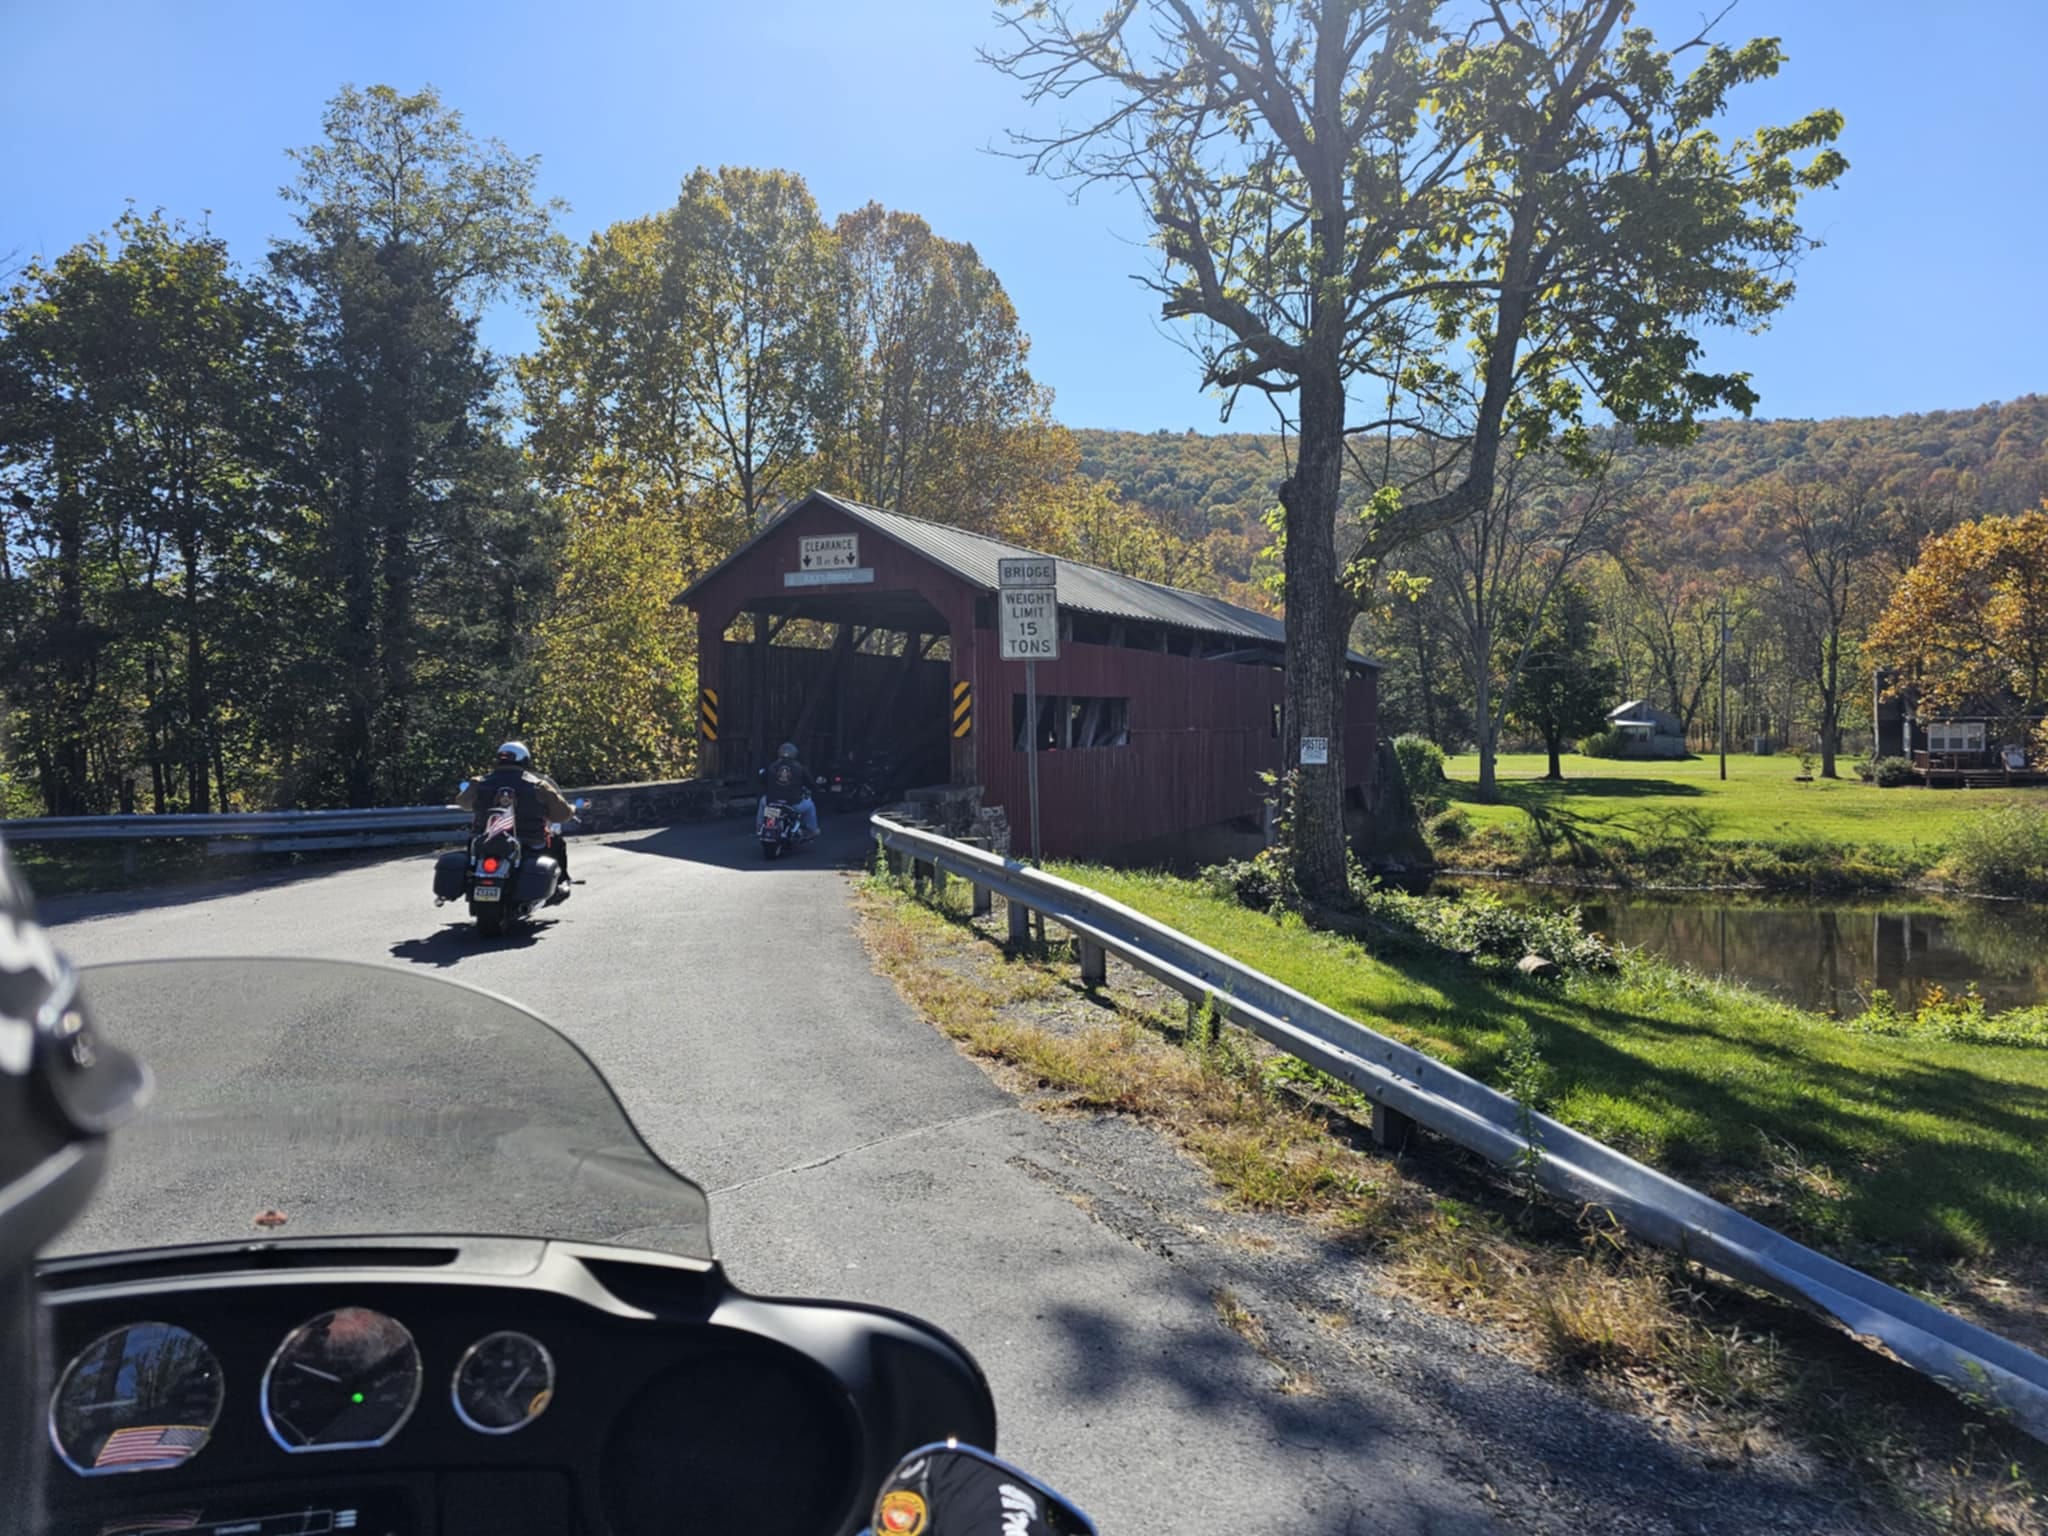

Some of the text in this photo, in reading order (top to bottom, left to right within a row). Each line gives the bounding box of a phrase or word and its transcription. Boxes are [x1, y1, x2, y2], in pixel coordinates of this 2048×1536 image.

[804, 539, 853, 552] CLEARANCE
[1004, 566, 1050, 578] BRIDGE
[1005, 592, 1051, 604] WEIGHT
[1012, 607, 1044, 618] LIMIT
[1019, 622, 1037, 636] 15
[1009, 639, 1050, 653] TONS
